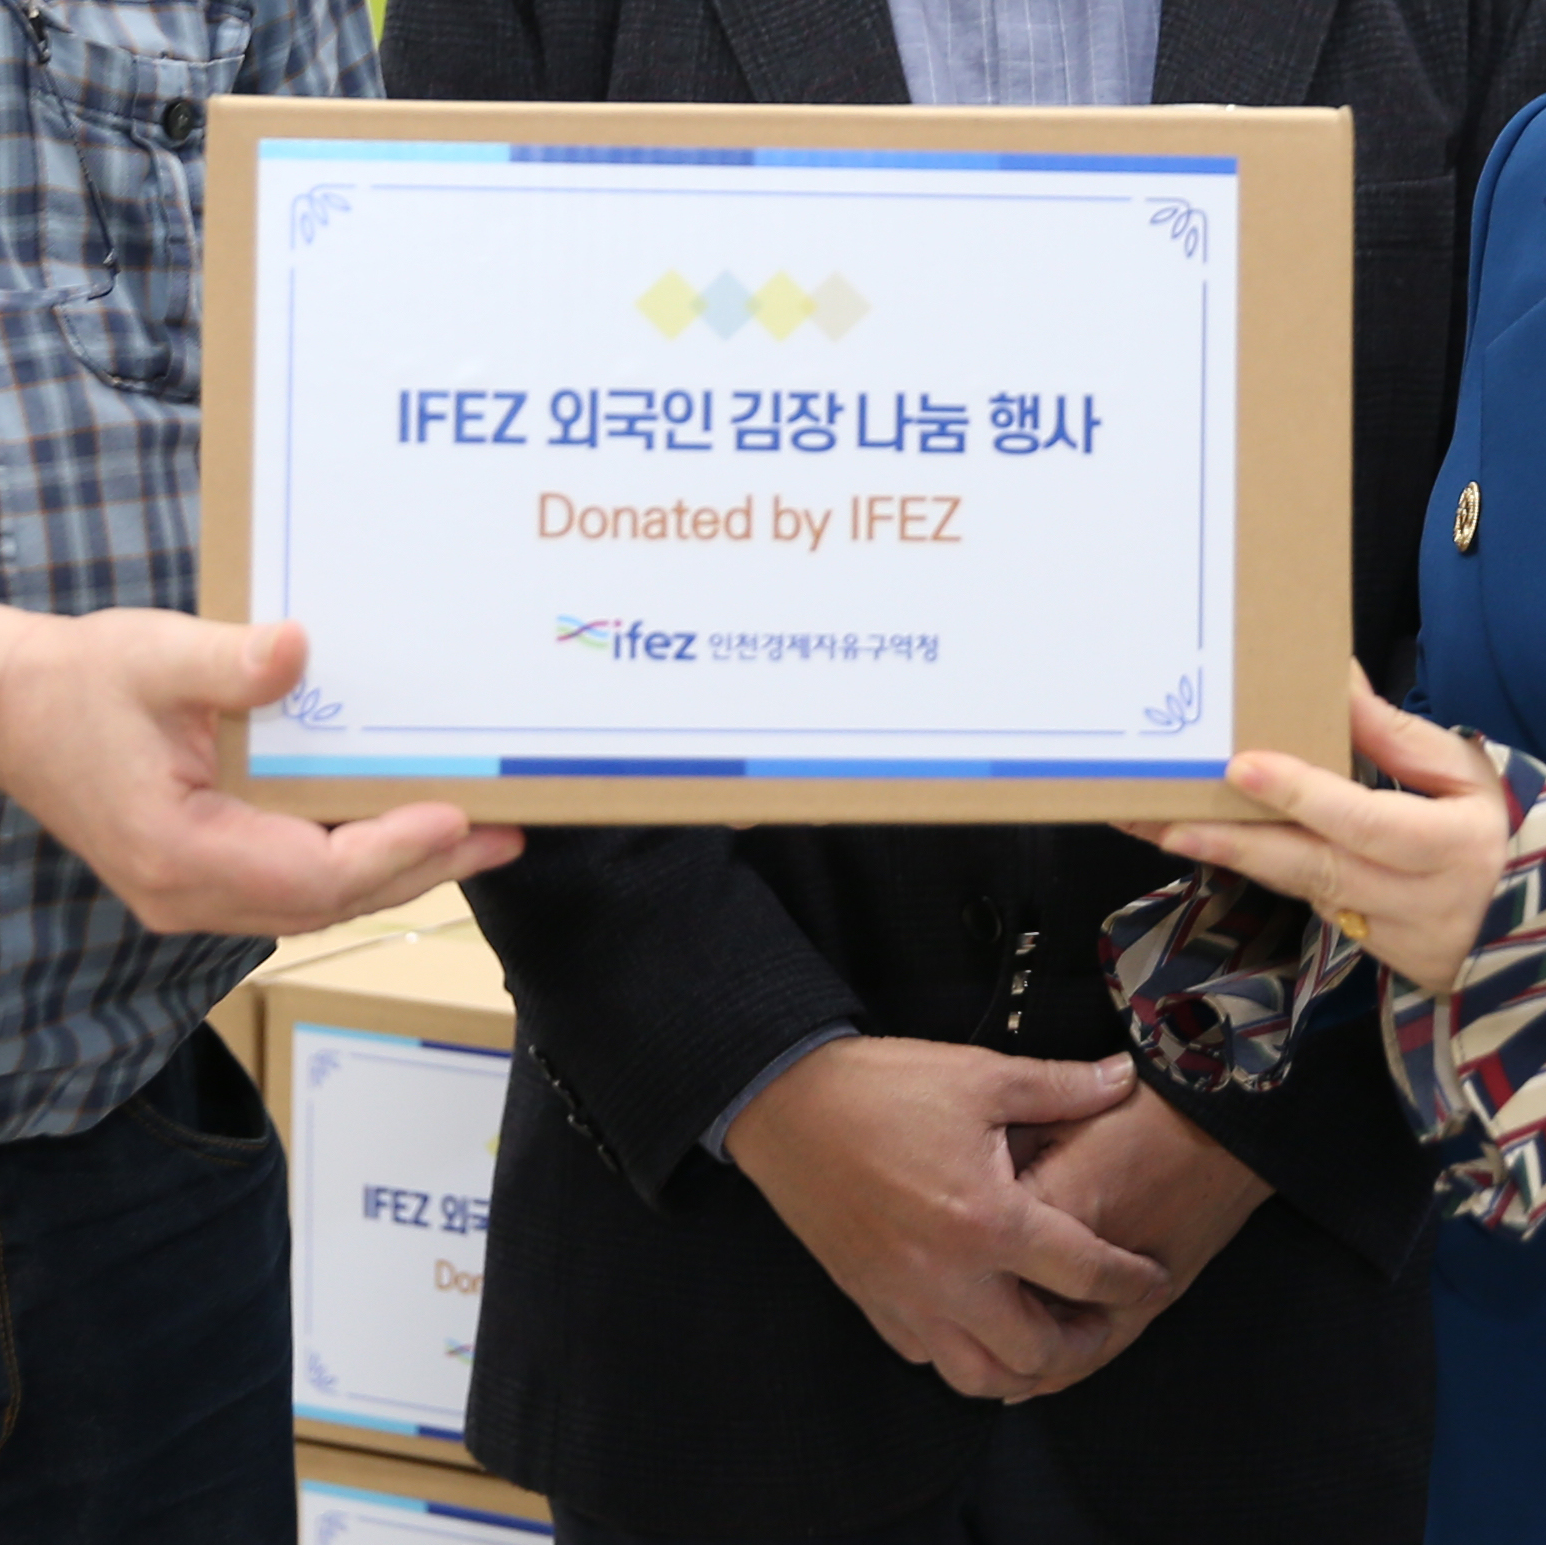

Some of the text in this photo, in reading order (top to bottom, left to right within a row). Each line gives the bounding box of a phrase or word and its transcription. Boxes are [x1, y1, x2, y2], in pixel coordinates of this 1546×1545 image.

[398, 388, 1103, 457] IFEZ 외국인 김장 나눔 행사
[537, 491, 963, 553] Donated by IFEZ
[612, 619, 941, 664] ifez 인천경제자유구역청
[363, 1185, 431, 1229] IFEZ
